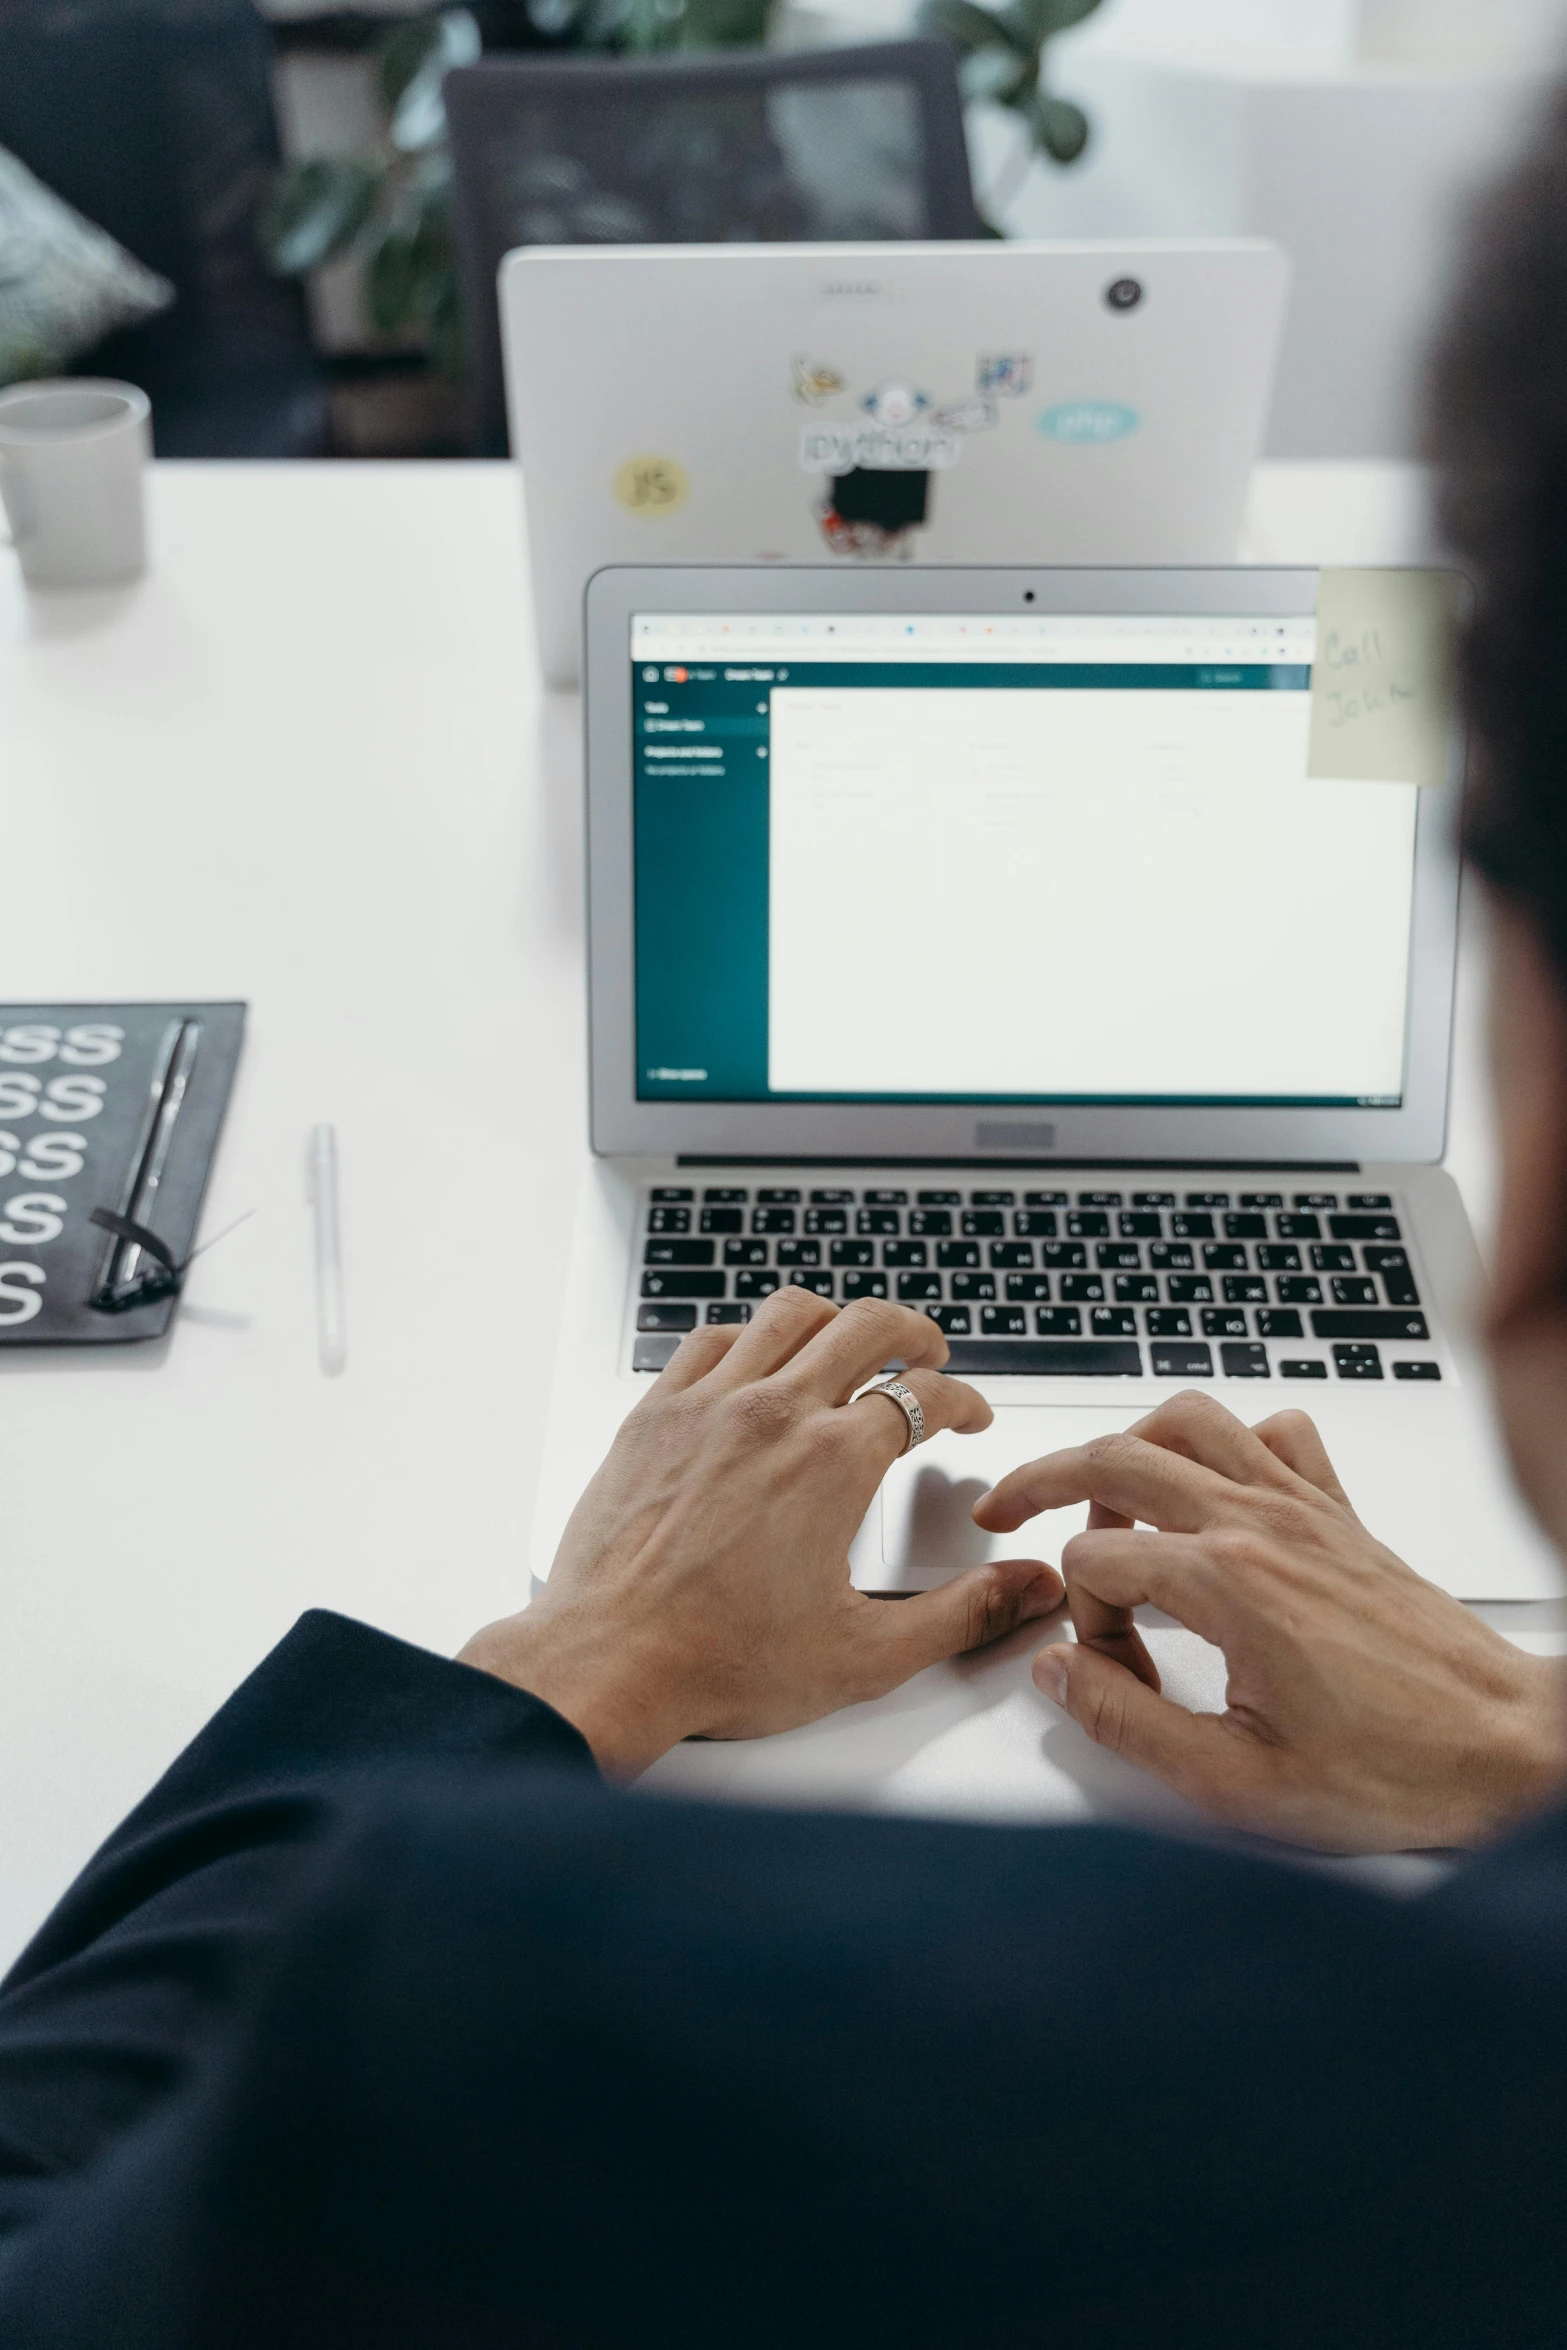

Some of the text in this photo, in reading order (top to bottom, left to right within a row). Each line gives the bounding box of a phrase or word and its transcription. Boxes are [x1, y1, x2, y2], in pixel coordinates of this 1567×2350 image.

[803, 427, 957, 475] python
[630, 467, 679, 506] JS
[1323, 630, 1381, 671] Call
[0, 1024, 125, 1065] SS
[0, 1192, 67, 1244] S
[1186, 1361, 1209, 1372] cmd
